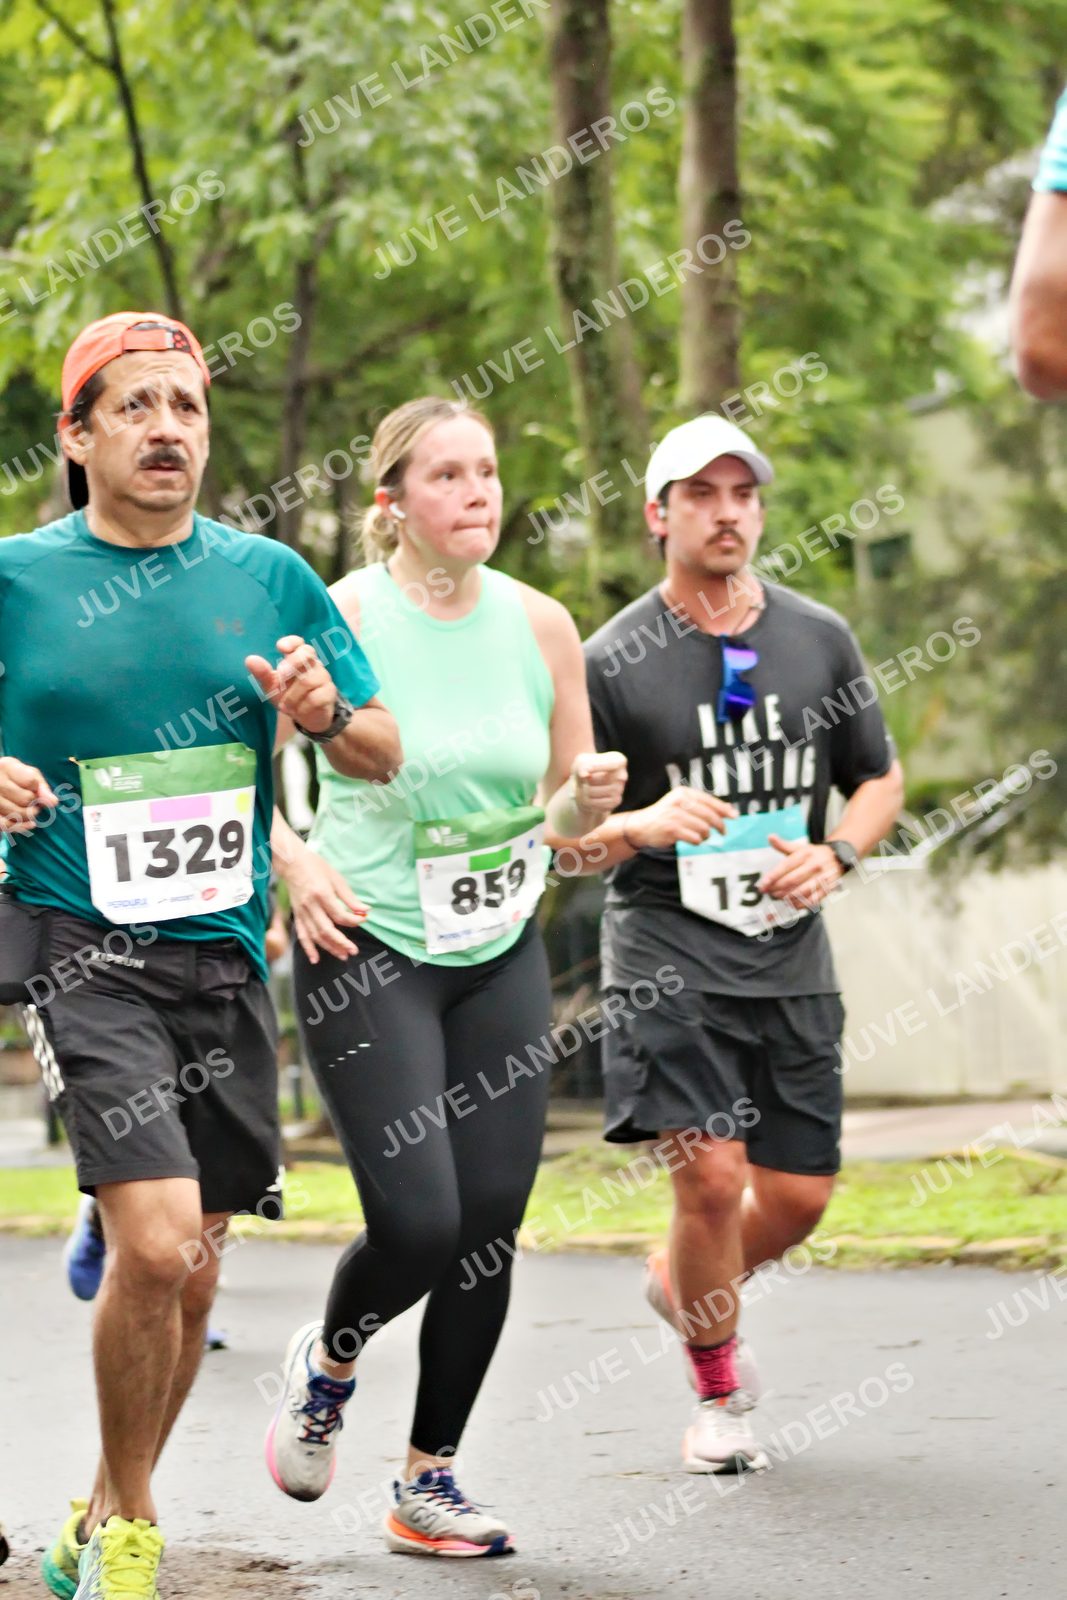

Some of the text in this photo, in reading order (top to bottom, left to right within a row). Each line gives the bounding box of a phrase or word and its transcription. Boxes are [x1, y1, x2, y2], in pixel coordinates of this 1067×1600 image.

[105, 819, 245, 882] 1329
[451, 858, 526, 916] 859
[711, 872, 782, 911] 13
